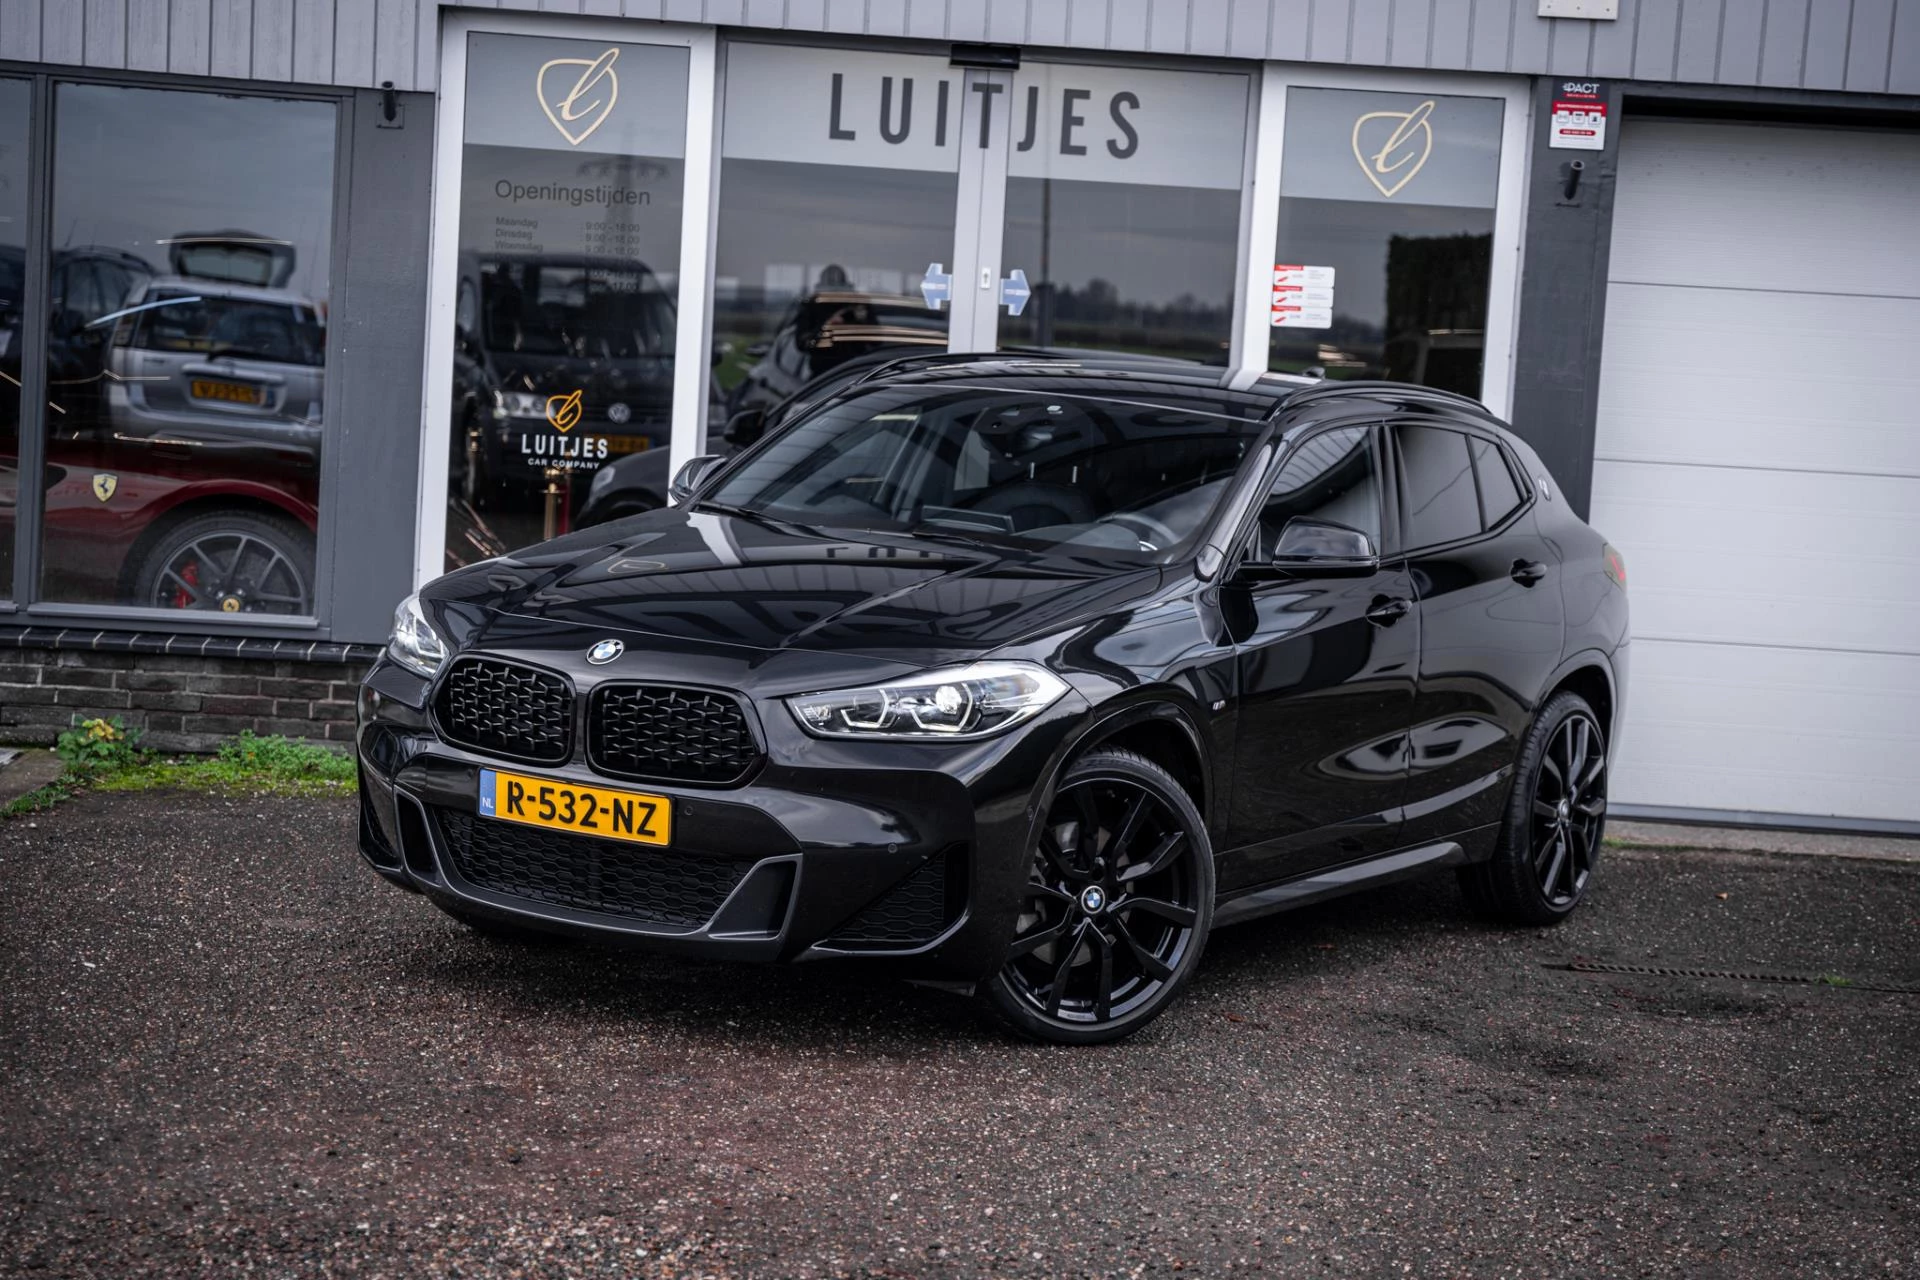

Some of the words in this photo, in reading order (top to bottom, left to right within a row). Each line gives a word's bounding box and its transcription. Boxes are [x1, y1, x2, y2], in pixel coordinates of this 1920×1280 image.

[829, 73, 1140, 159] LUITJES
[495, 179, 650, 207] Openingstijden
[521, 433, 608, 459] LUITJES
[528, 457, 547, 466] CAR
[552, 458, 600, 469] COMPANY
[482, 796, 494, 809] NL
[507, 780, 657, 837] R-532-NZ
